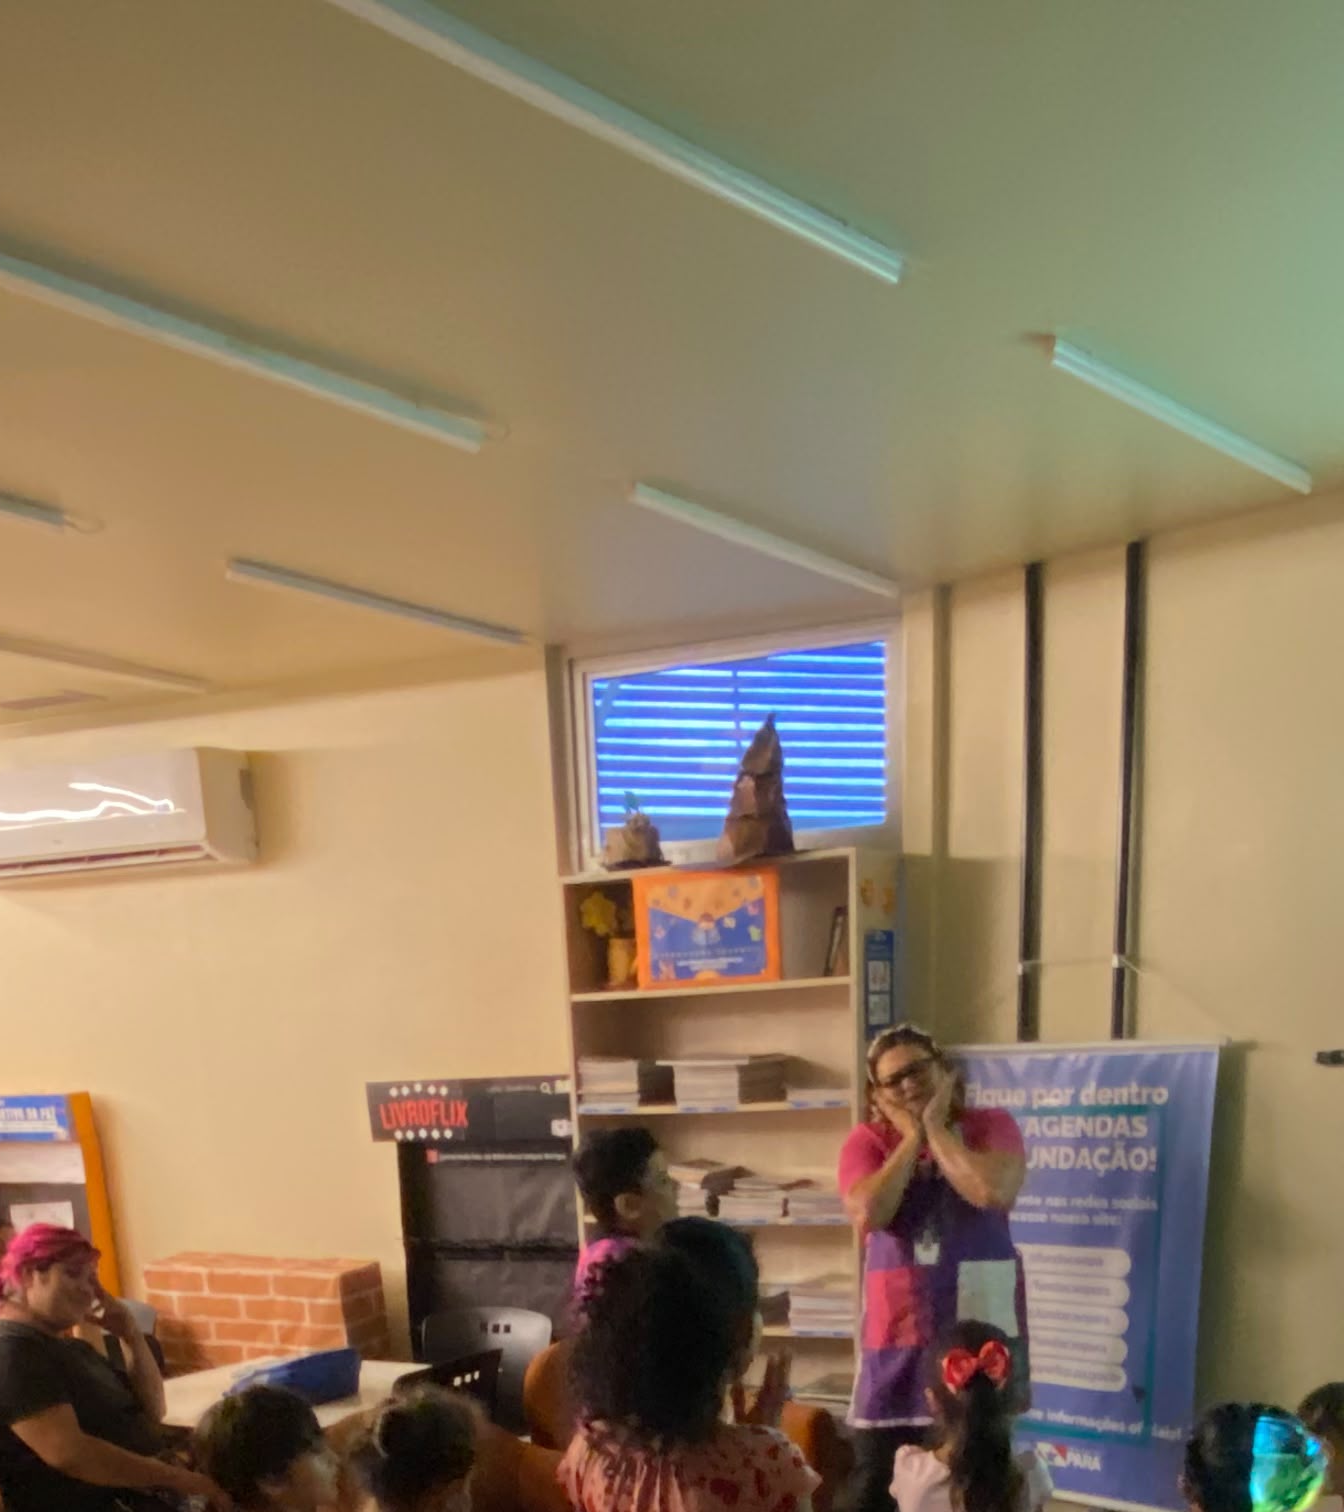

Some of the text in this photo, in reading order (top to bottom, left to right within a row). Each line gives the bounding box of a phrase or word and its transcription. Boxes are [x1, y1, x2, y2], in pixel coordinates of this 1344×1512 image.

[965, 1080, 1169, 1110] Fique por dentro
[379, 1099, 469, 1130] LIVROFLIX
[1024, 1114, 1148, 1138] AGENDAS
[1026, 1141, 1158, 1177] UNDAÇÃO!
